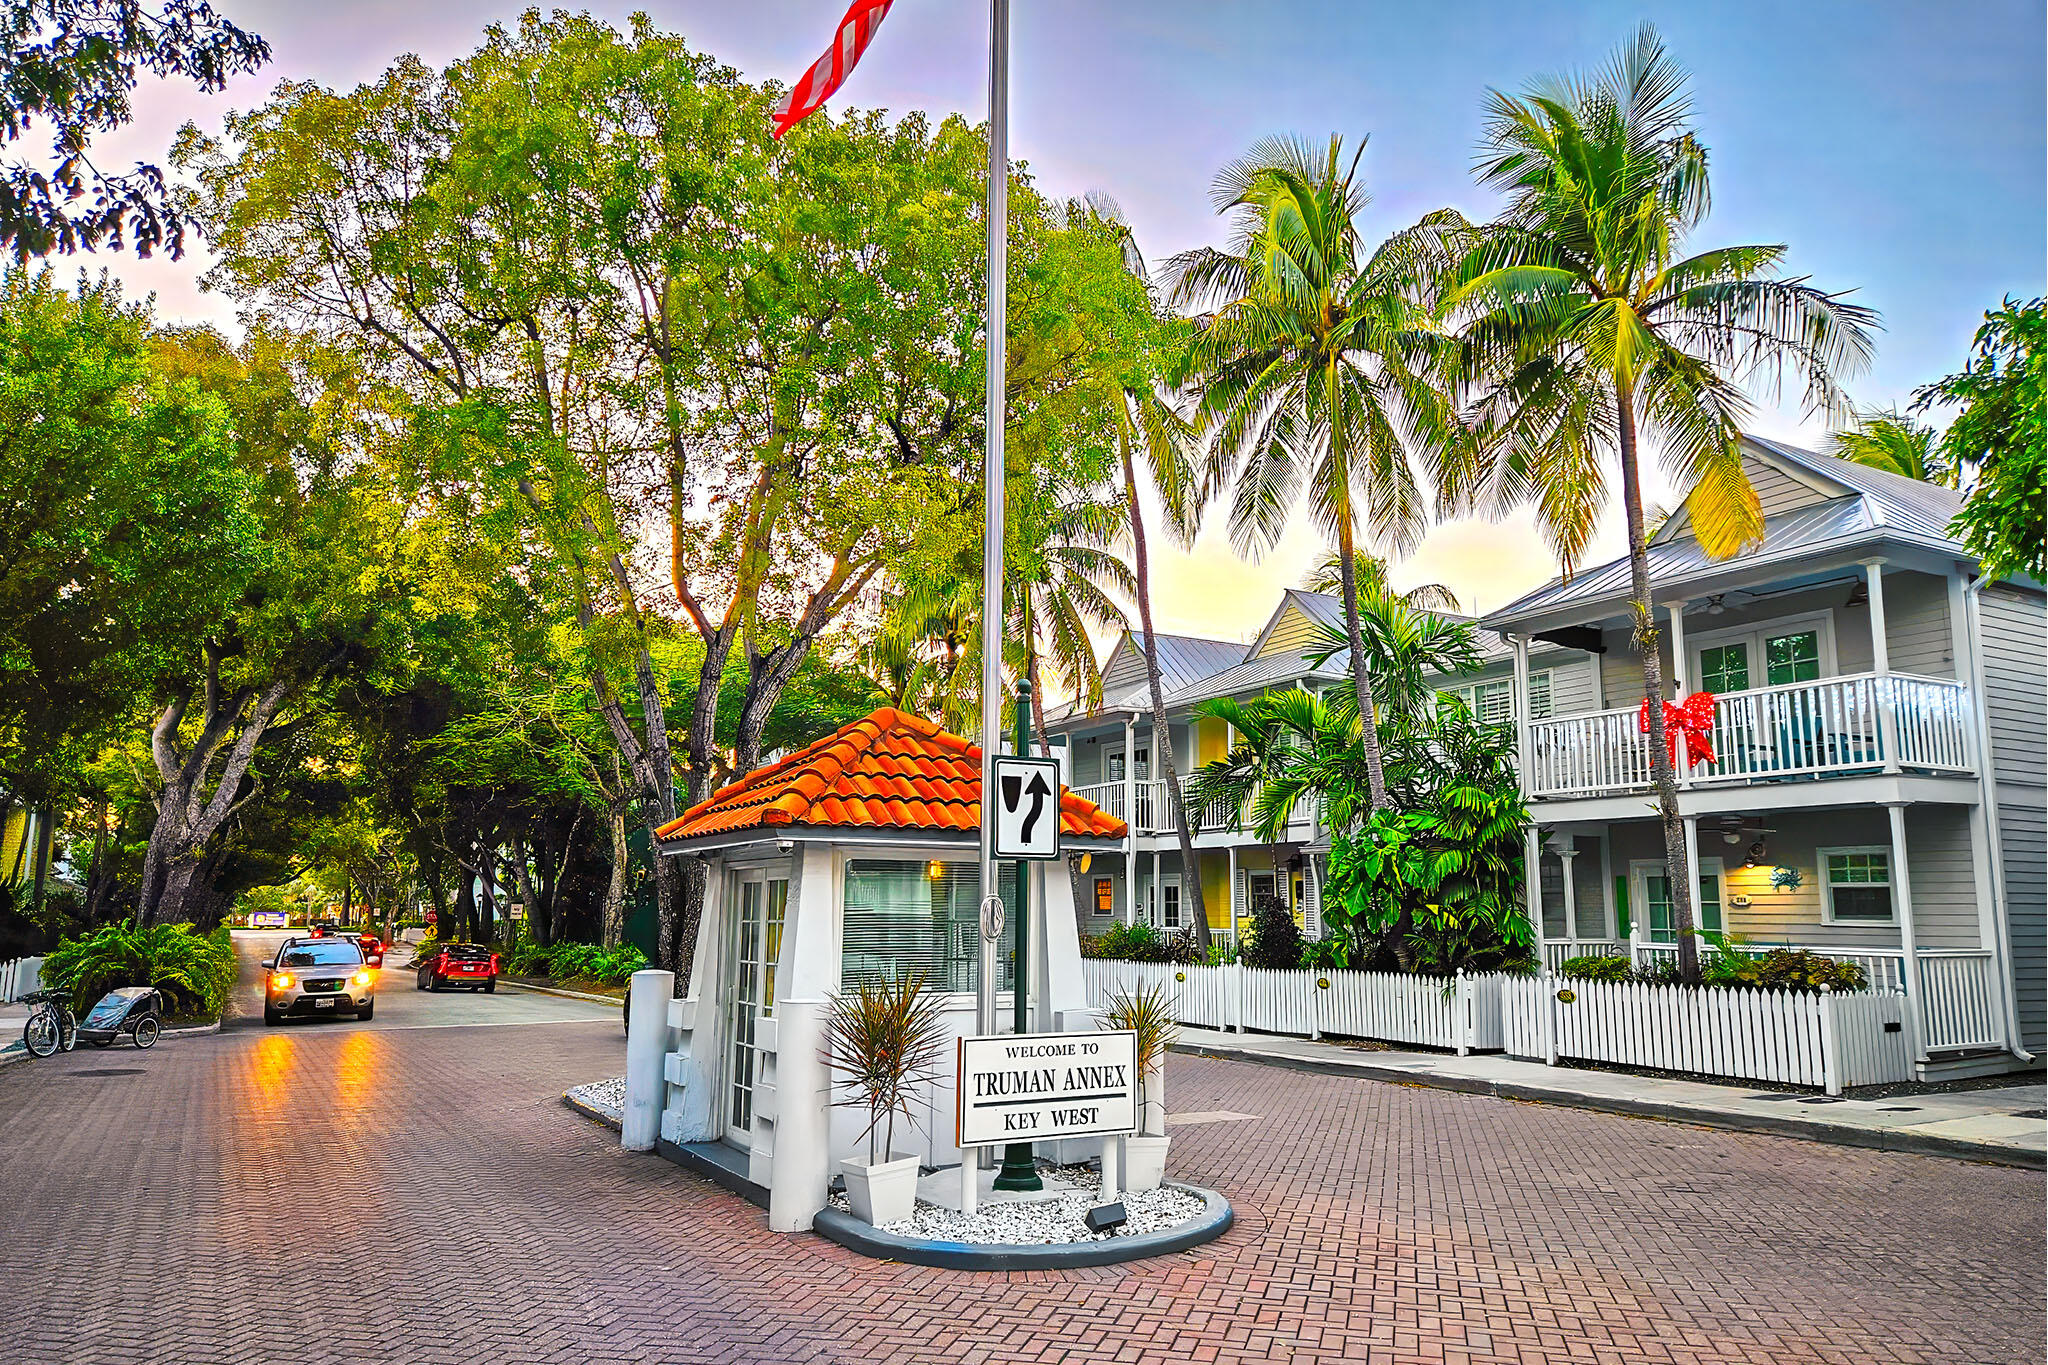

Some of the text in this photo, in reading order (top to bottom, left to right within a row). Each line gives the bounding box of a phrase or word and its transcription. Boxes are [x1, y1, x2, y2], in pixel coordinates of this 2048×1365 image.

[1006, 1042, 1099, 1058] WELCOME TO
[973, 1065, 1127, 1096] TRUMAN ANNEX
[1004, 1107, 1099, 1130] KEY WEST
